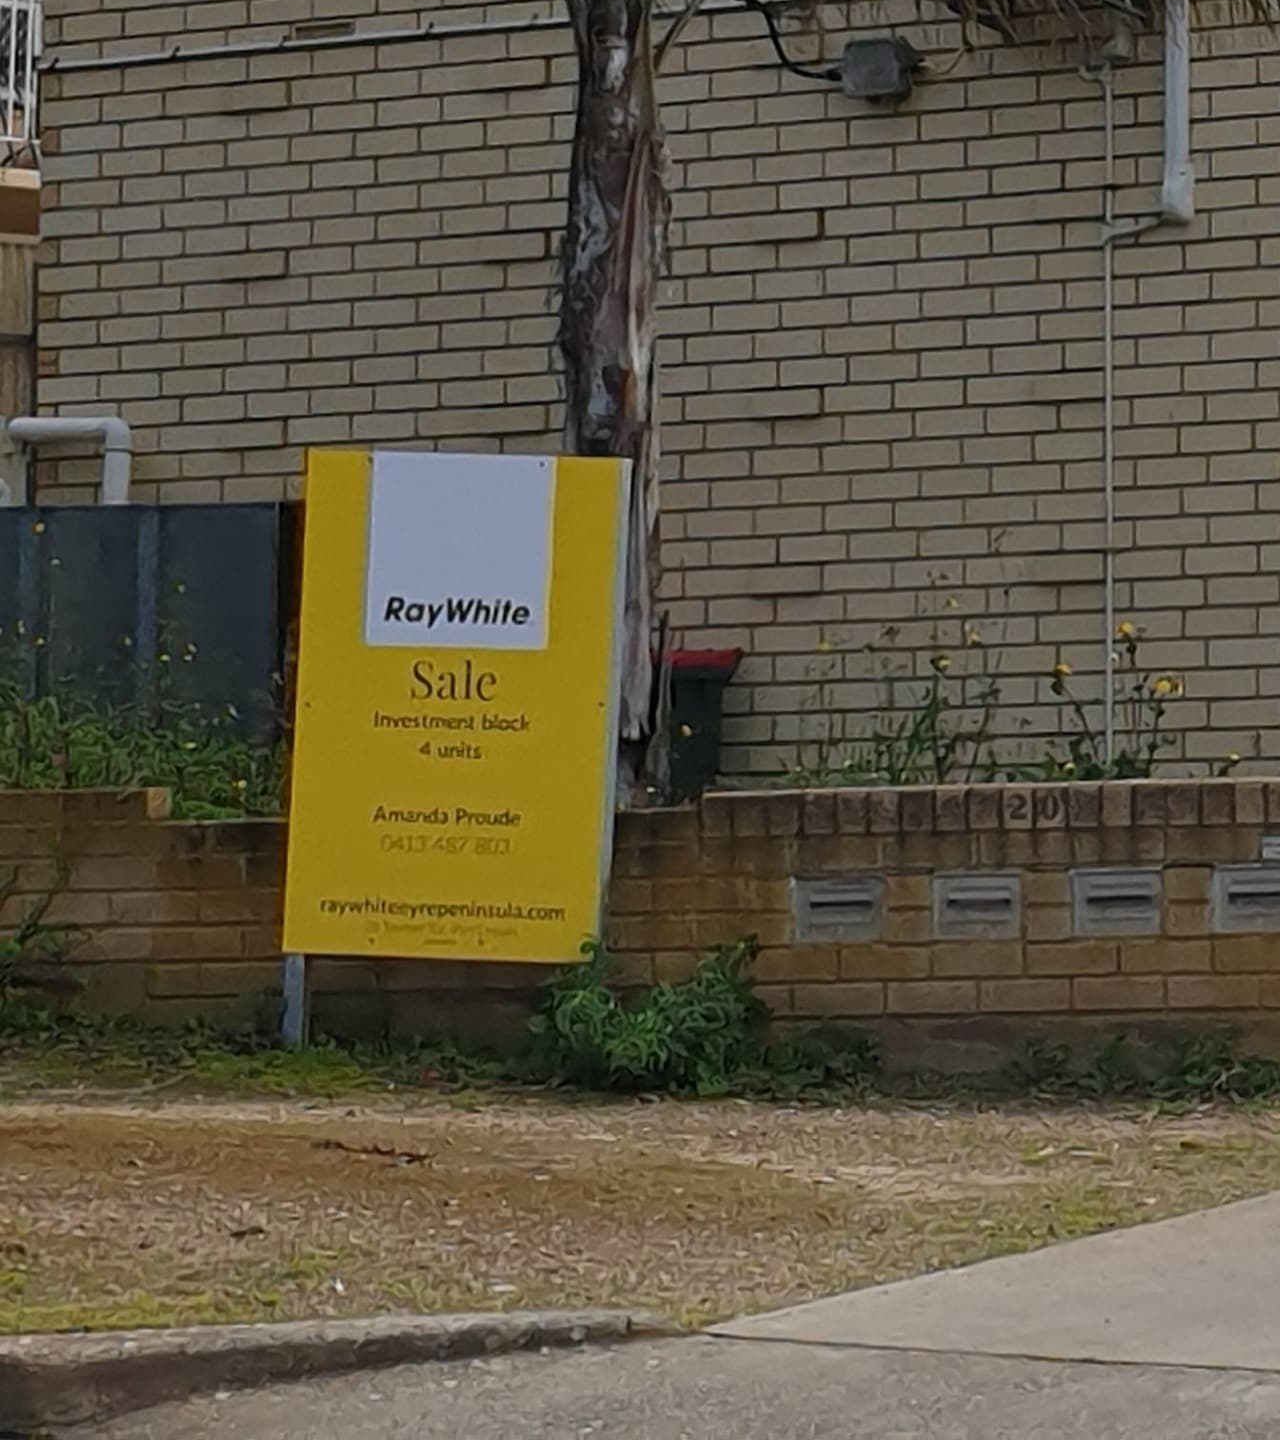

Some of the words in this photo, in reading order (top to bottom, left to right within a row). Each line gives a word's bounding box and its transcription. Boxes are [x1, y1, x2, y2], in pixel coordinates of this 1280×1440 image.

[384, 596, 530, 628] RayWhite
[410, 660, 498, 702] Sale
[373, 710, 476, 731] Investment
[481, 714, 530, 732] block
[418, 741, 431, 756] 4
[437, 742, 482, 759] units
[373, 806, 450, 825] Amanda
[455, 808, 522, 826] Proude
[1007, 793, 1060, 821] 20
